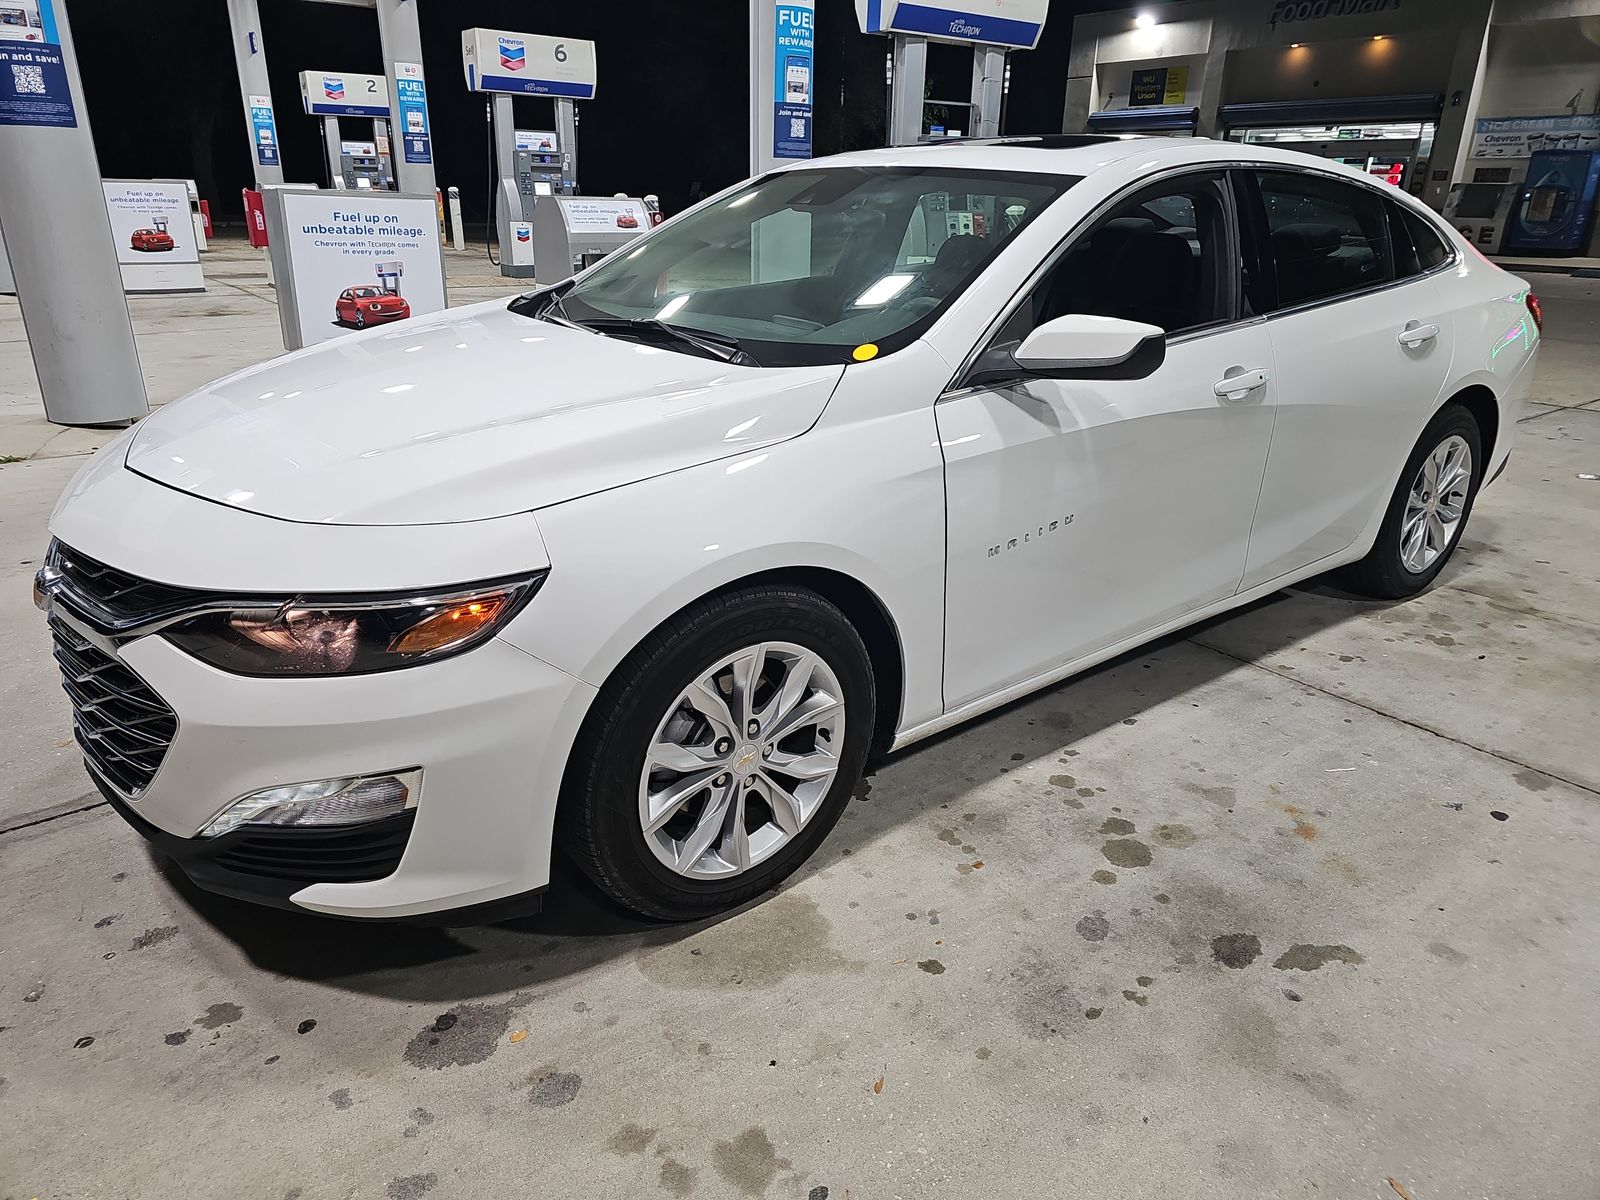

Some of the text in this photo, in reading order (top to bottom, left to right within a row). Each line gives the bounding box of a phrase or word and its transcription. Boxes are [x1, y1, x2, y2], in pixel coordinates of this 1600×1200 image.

[779, 10, 813, 29] FUEL
[790, 28, 810, 38] WITH
[949, 22, 982, 36] TECHRON
[498, 37, 525, 46] Chevron
[12, 52, 33, 62] and
[35, 55, 60, 64] save!
[555, 44, 568, 62] 6
[367, 80, 377, 93] 2
[398, 81, 424, 92] FUEL
[253, 108, 271, 116] FUEL
[1484, 134, 1522, 143] Chevron
[333, 212, 399, 225] Fuel up on
[302, 224, 427, 238] unbeatable mileage.
[314, 240, 348, 248] Chevron
[350, 240, 366, 248] with
[368, 240, 396, 248] TECHRON
